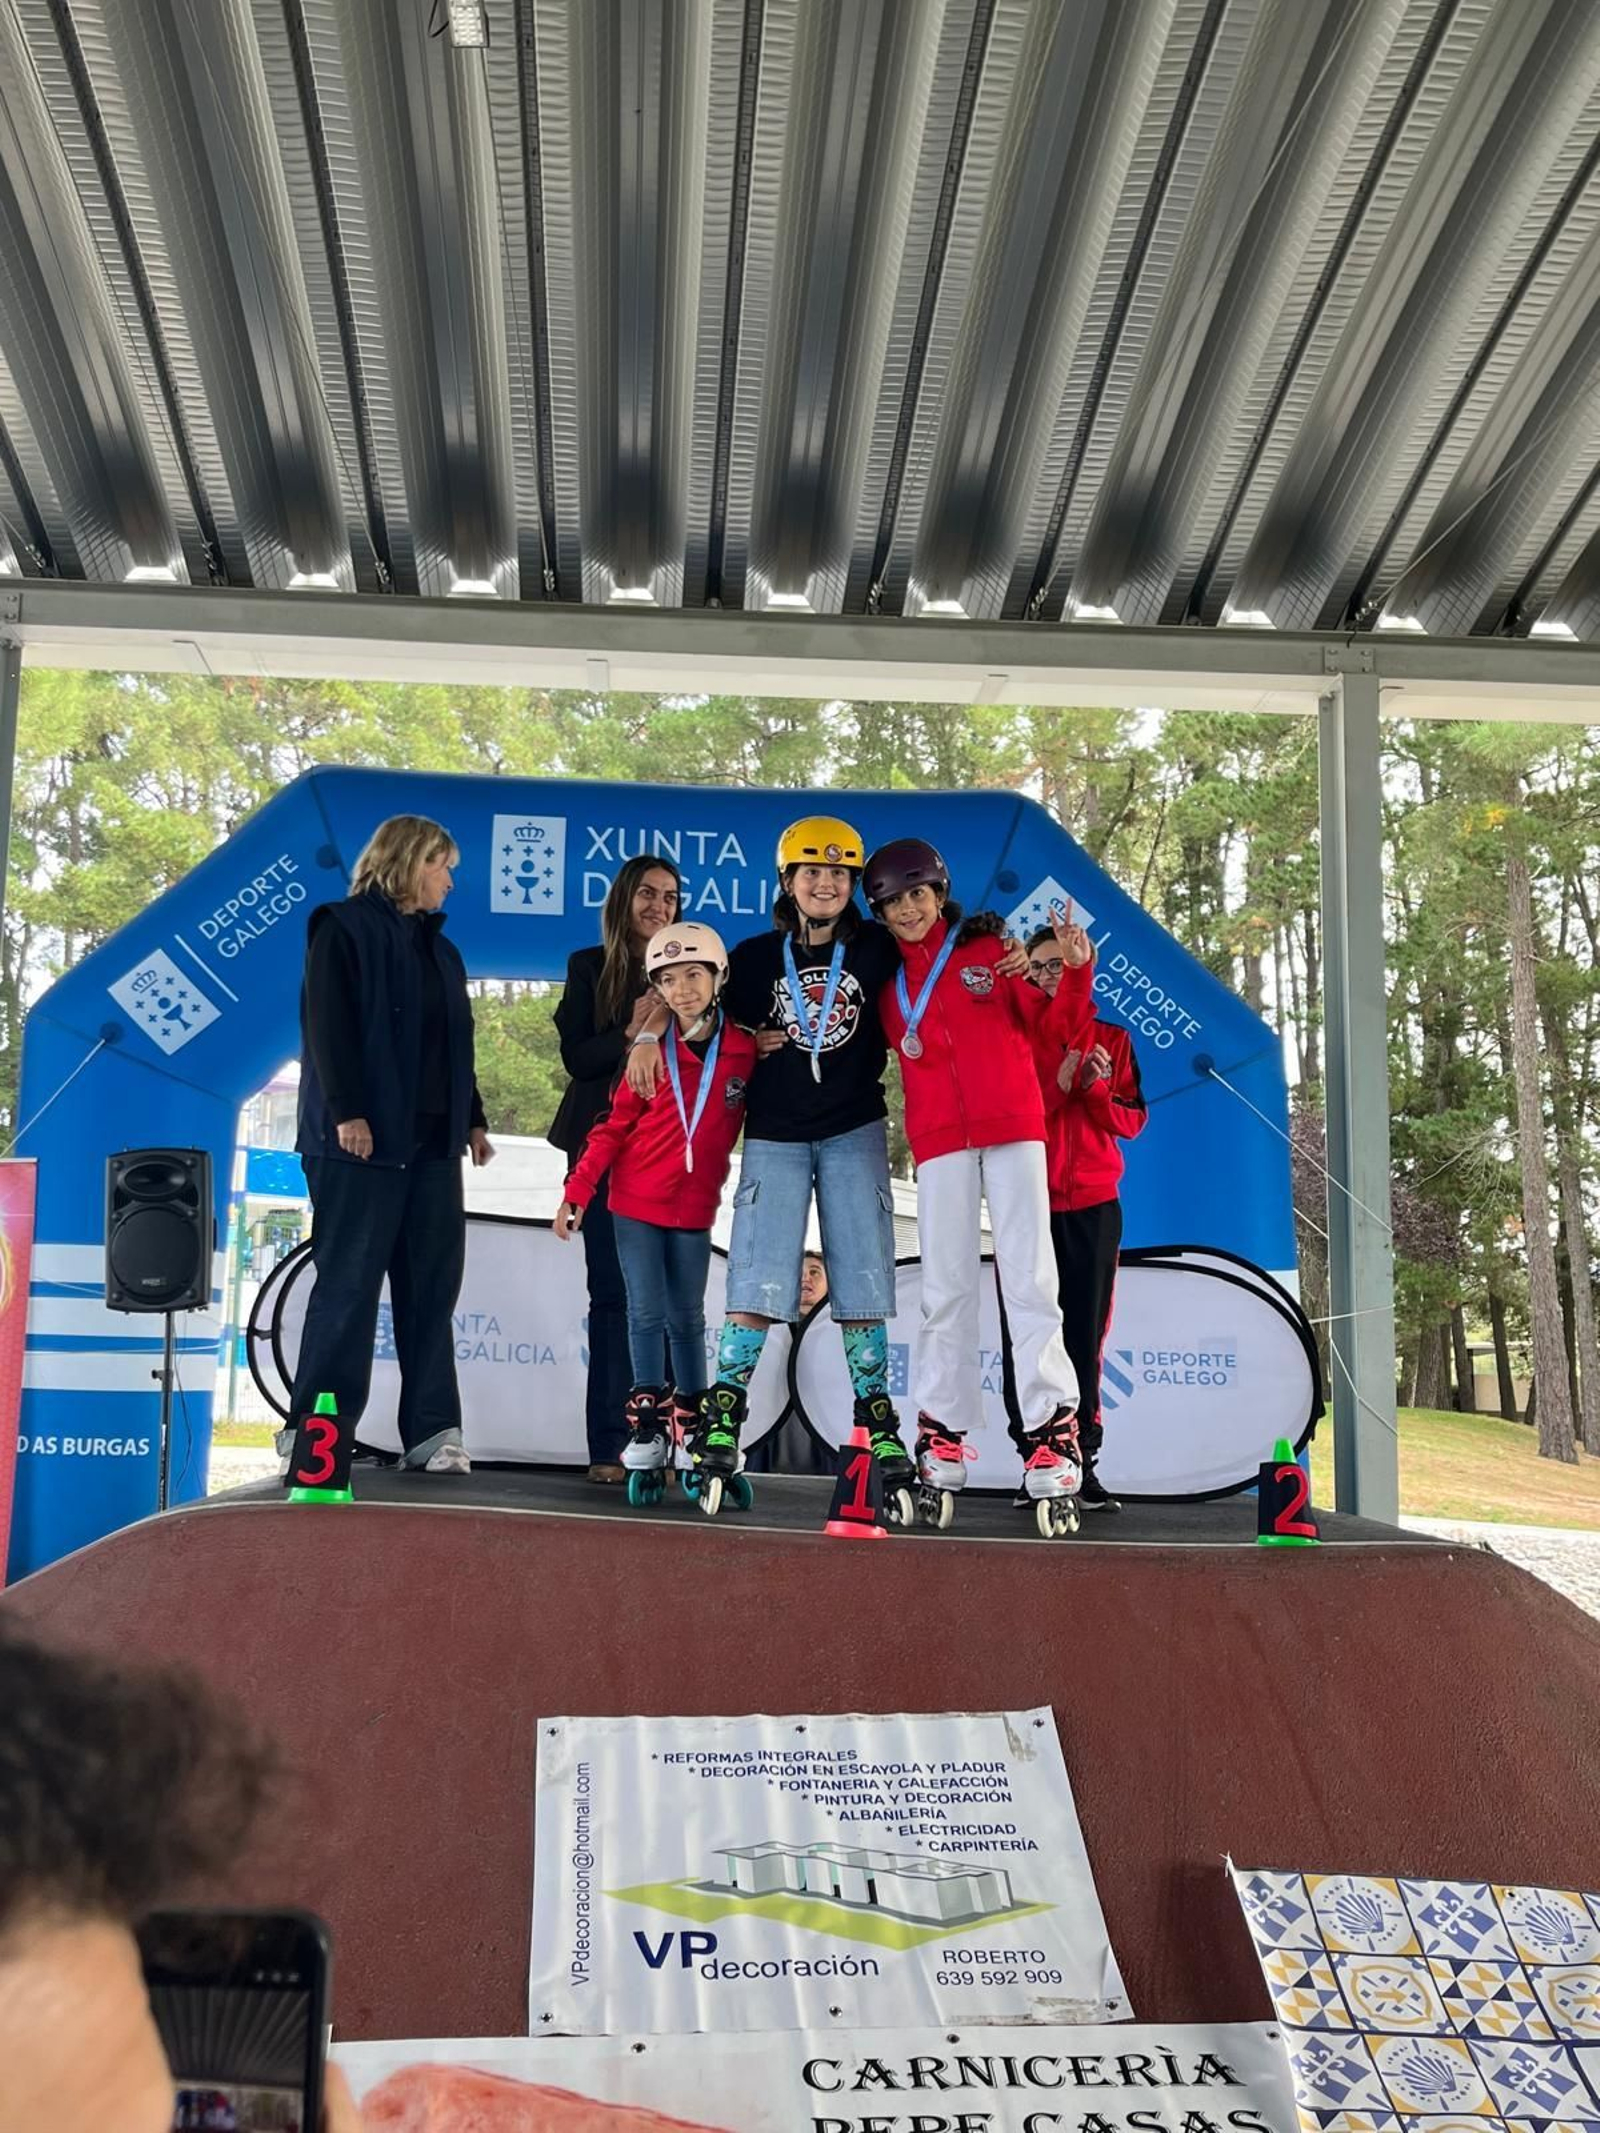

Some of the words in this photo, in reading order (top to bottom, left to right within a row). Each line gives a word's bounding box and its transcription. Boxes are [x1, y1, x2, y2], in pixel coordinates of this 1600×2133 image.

[585, 826, 747, 867] XUNTA
[198, 854, 299, 939] DEPORTE
[217, 882, 307, 957] GALEGO
[1108, 953, 1202, 1040] DEPORTE
[1092, 973, 1174, 1049] GALEGO
[455, 1339, 557, 1365] GALICIA
[1142, 1351, 1237, 1369] DEPORTE
[1143, 1369, 1227, 1386] GALEGO
[32, 1436, 58, 1454] AS
[62, 1438, 150, 1456] BURGAS
[297, 1418, 339, 1484] 3
[839, 1456, 876, 1520] 1
[1273, 1465, 1317, 1537] 2
[664, 1752, 753, 1764] REFORMAS
[758, 1749, 857, 1762] INTEGRALES
[701, 1763, 807, 1778] DECORACIÓN
[812, 1764, 833, 1776] EN
[839, 1763, 922, 1775] ESCAYOLA
[926, 1763, 936, 1774] Y
[941, 1761, 1006, 1774] PLADUR
[779, 1779, 879, 1791] FONTANERIA
[884, 1780, 893, 1790] Y
[899, 1775, 1009, 1789] CALEFACCIÓN
[814, 1794, 885, 1806] PINTURA
[889, 1795, 899, 1805] Y
[905, 1790, 1012, 1803] DECORACIÓN
[839, 1807, 947, 1821] ALBAÑILERÍA
[899, 1823, 1017, 1836] ELECTRICIDAD
[928, 1837, 1039, 1852] CARPINTERÍA
[571, 1762, 594, 1986] VPdecoracion@hotmail.com
[633, 1931, 718, 1969] VP
[701, 1955, 880, 1980] decoración
[943, 1949, 1045, 1964] ROBERTO
[936, 1971, 974, 1985] 639
[981, 1970, 1019, 1985] 592
[1024, 1970, 1062, 1984] 909
